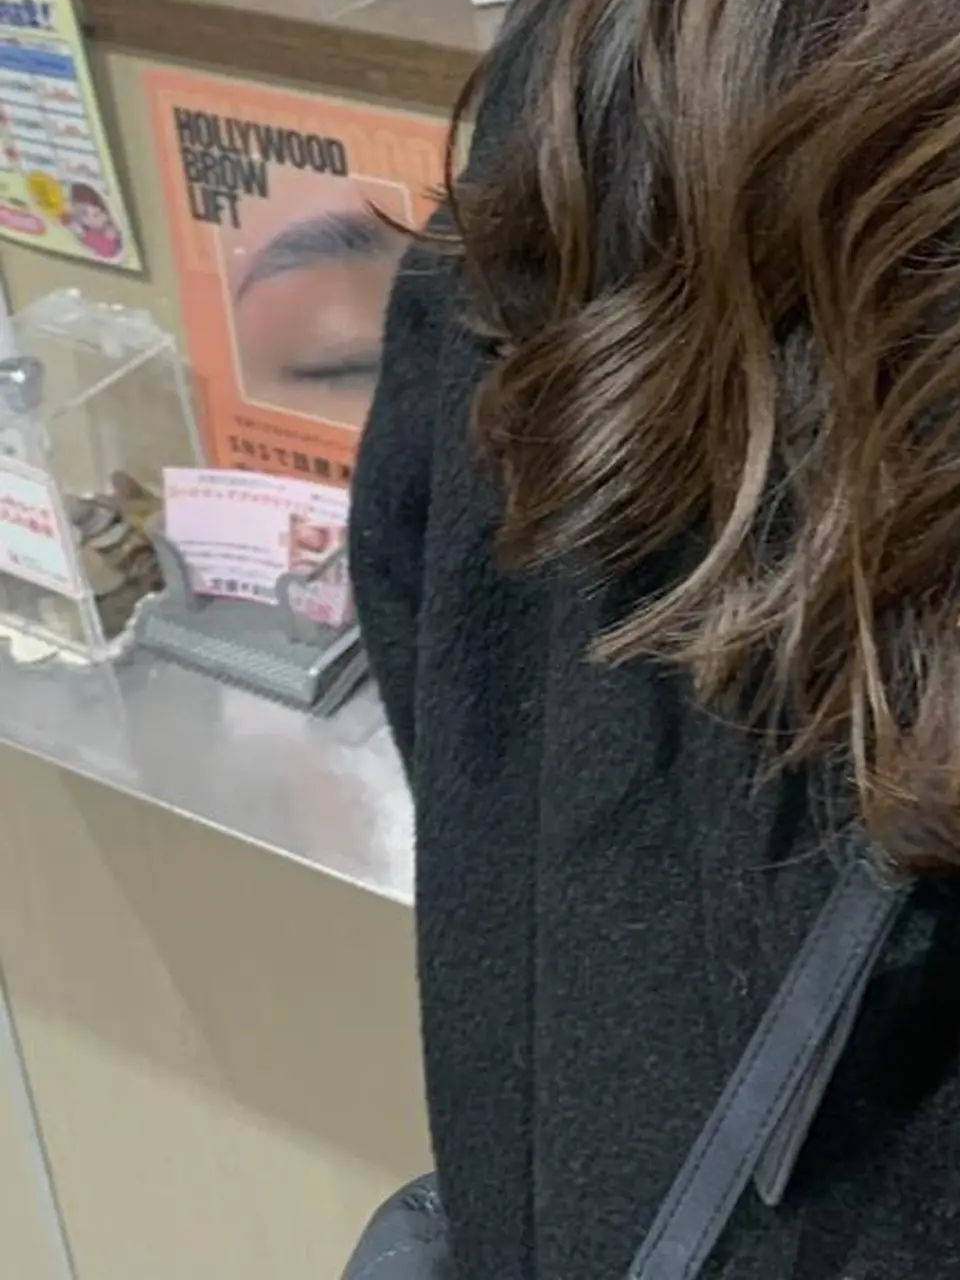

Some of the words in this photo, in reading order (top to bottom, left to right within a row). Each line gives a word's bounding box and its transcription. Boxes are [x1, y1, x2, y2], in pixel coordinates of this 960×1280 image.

[174, 106, 348, 177] HOLLYWOOD
[183, 143, 268, 199] BROW
[188, 182, 241, 229] LIFT
